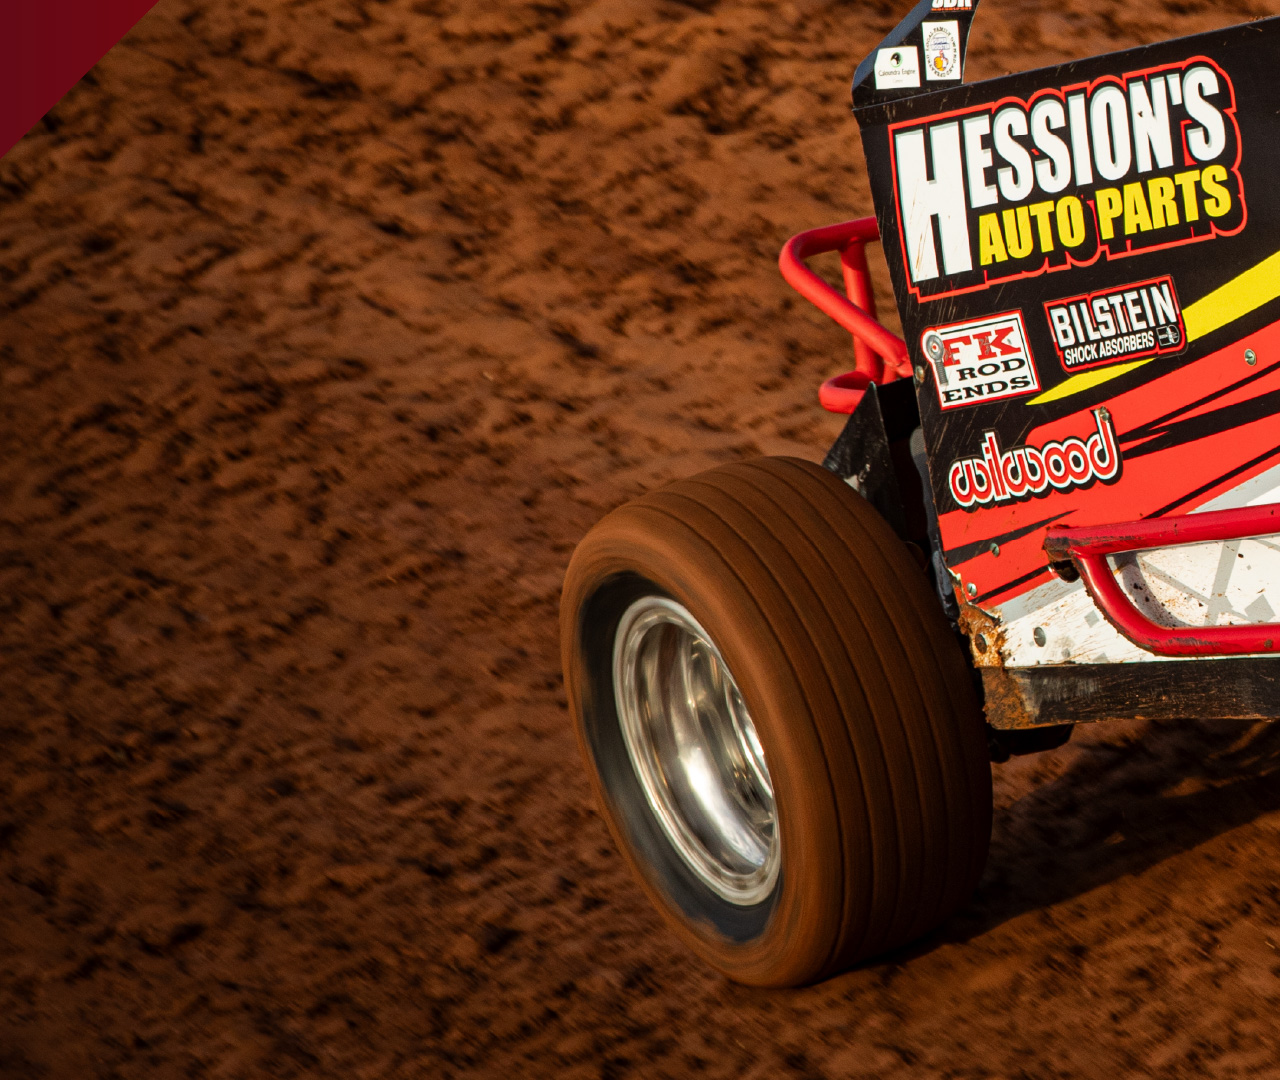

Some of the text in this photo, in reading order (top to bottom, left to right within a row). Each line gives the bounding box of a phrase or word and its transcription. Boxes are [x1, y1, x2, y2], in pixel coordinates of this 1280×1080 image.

[895, 65, 1227, 284] HESSION'S
[979, 164, 1232, 267] AUTO PARTS
[1050, 283, 1177, 348] BILSTEIN
[941, 325, 1022, 367] FK
[958, 357, 1027, 382] ROD
[1064, 331, 1155, 366] SHOCK ABSORBERS
[941, 375, 1031, 404] ENDS
[948, 407, 1119, 507] wilwood
